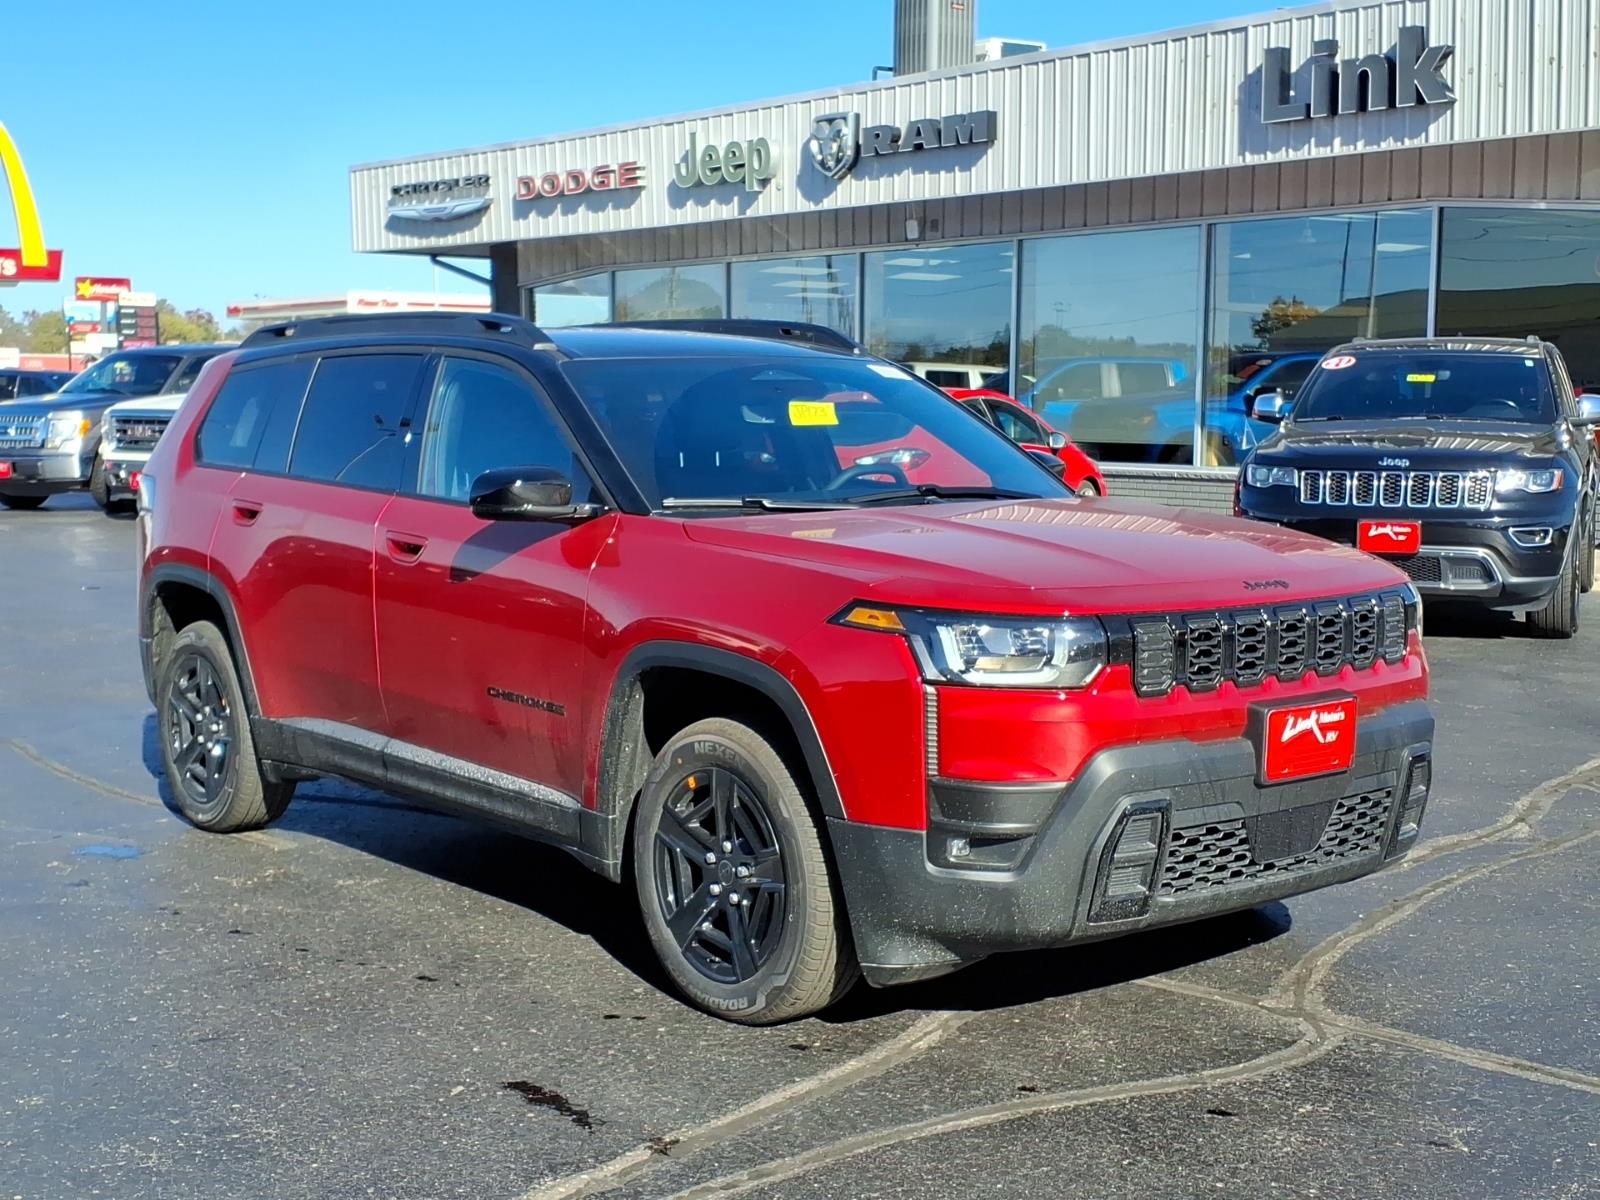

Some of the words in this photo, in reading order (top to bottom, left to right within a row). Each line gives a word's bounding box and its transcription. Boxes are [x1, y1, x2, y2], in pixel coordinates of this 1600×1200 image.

[1261, 25, 1457, 124] Link
[861, 110, 997, 157] RAM
[673, 131, 773, 192] Jeep
[390, 174, 492, 199] CHRYSLER
[516, 160, 646, 200] DODGE
[1378, 456, 1410, 468] Jeep
[487, 686, 566, 717] CHEROKEE
[1280, 709, 1325, 743] Link
[694, 741, 745, 769] NEXEN
